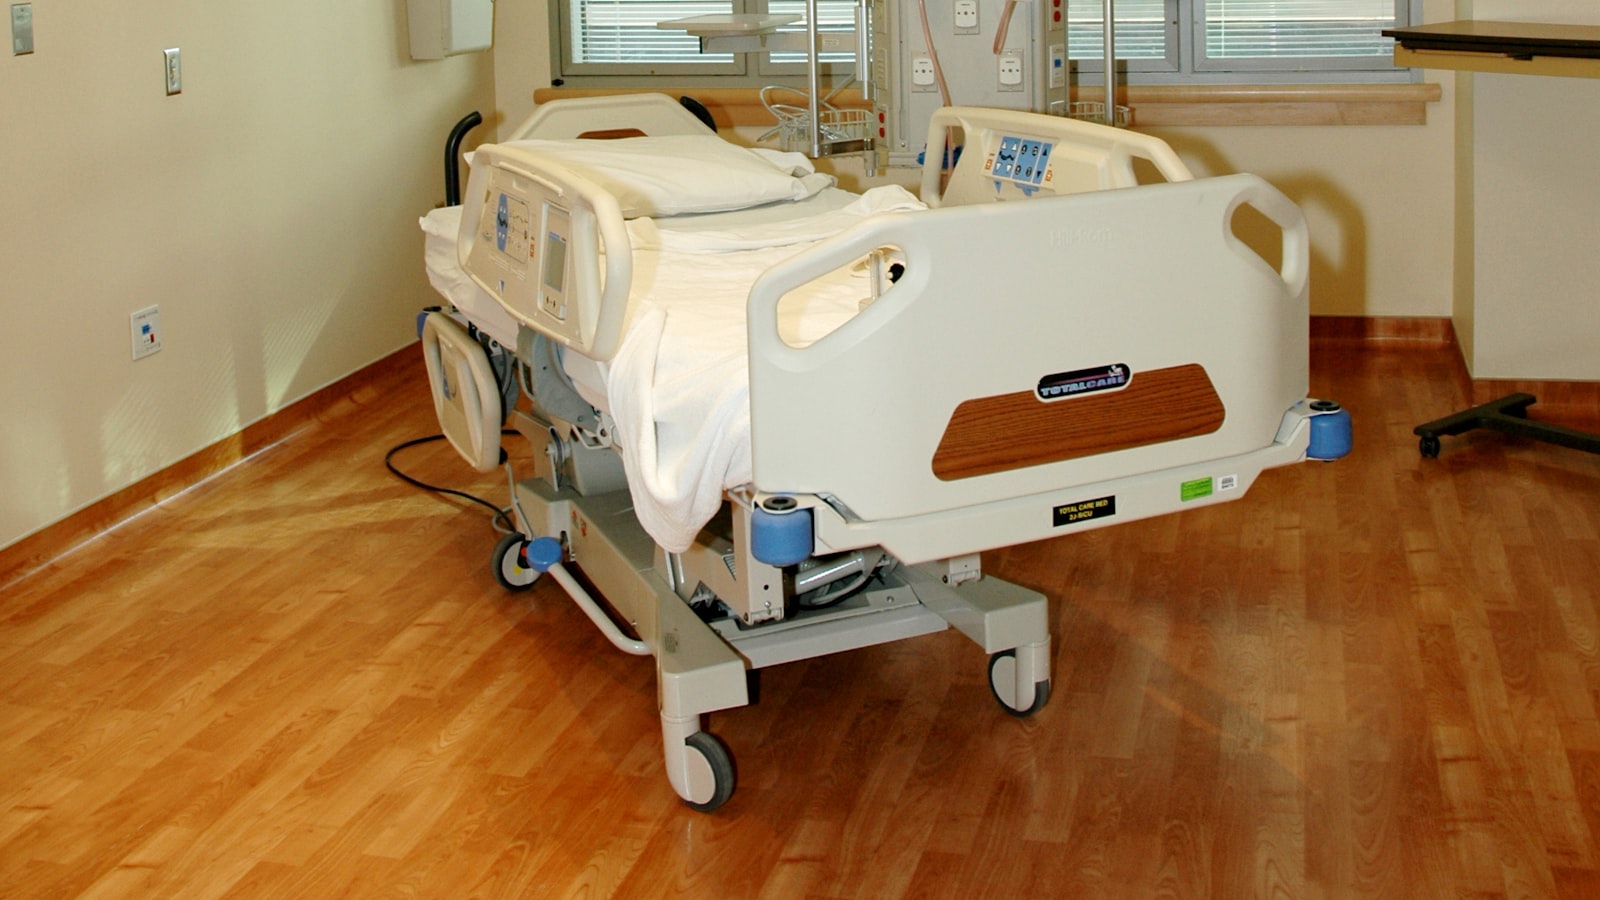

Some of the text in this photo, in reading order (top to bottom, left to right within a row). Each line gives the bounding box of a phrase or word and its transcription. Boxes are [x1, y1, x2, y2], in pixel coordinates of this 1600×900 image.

[1041, 375, 1125, 396] TOTALCARE
[1059, 506, 1078, 515] TOTAL
[1078, 502, 1095, 511] CARE
